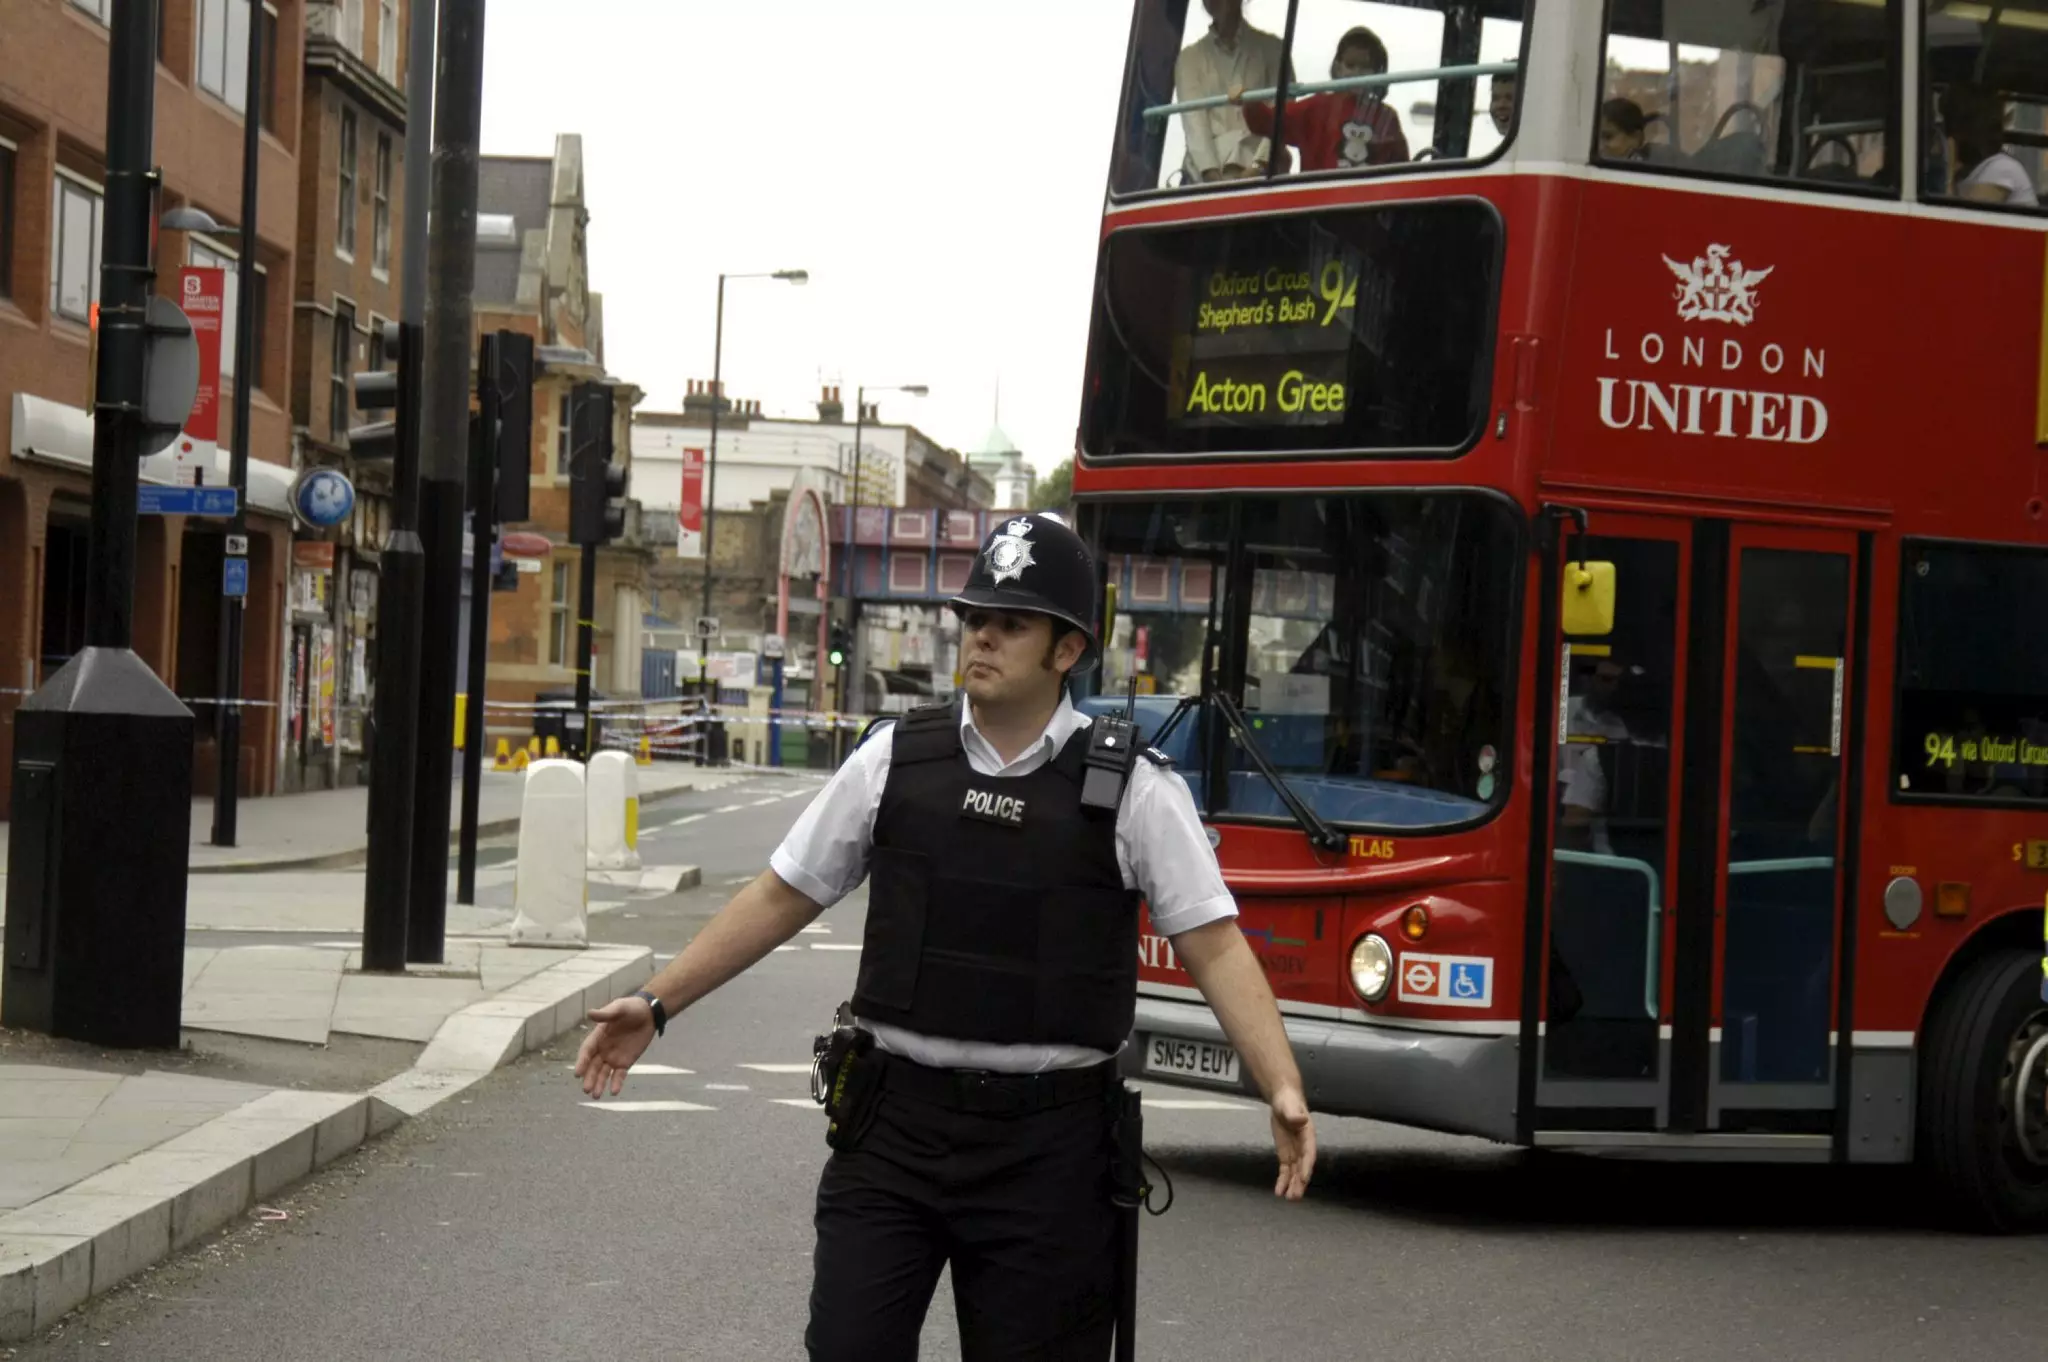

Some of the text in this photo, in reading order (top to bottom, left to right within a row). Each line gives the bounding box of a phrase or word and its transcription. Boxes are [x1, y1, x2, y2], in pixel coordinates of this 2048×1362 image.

[1210, 271, 1260, 297] Oxford
[1264, 267, 1310, 292] Circus
[1198, 295, 1315, 334] Shepherd's Bush
[1605, 328, 1825, 378] LONDON
[1187, 371, 1266, 412] Acton
[1597, 377, 1828, 444] UNITED
[1925, 733, 1957, 768] 94
[963, 788, 1025, 822] POLICE
[1138, 934, 1182, 972] NIT
[1154, 1040, 1234, 1076] SN53 EUY
